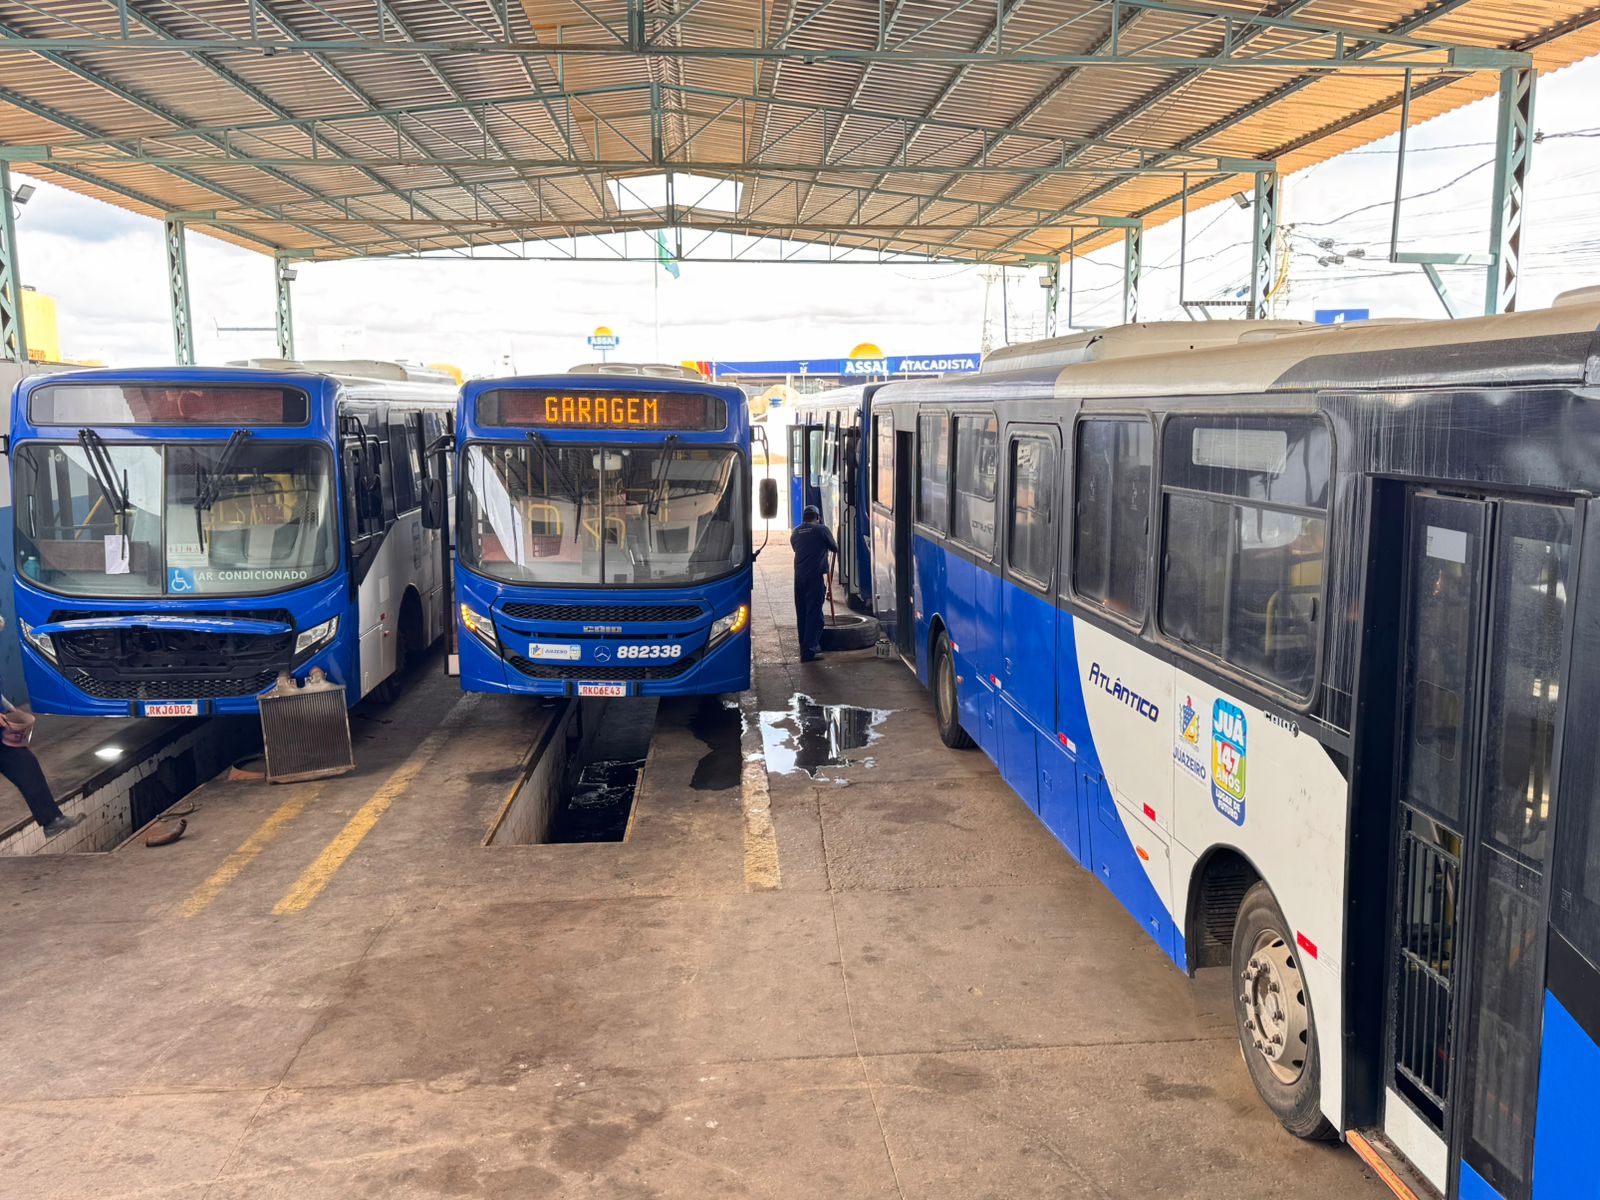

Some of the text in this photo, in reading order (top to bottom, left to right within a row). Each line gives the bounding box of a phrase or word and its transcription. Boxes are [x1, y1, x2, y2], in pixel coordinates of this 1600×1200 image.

[899, 359, 975, 372] ATACADISTA
[545, 396, 658, 424] GARAGEM
[198, 570, 307, 581] AR CONDICIONADO
[616, 644, 682, 659] 882338
[582, 686, 621, 695] RKC6E43
[1213, 709, 1244, 746] JUÁ
[1172, 746, 1206, 780] JUAZEIRO
[1216, 741, 1241, 776] 147
